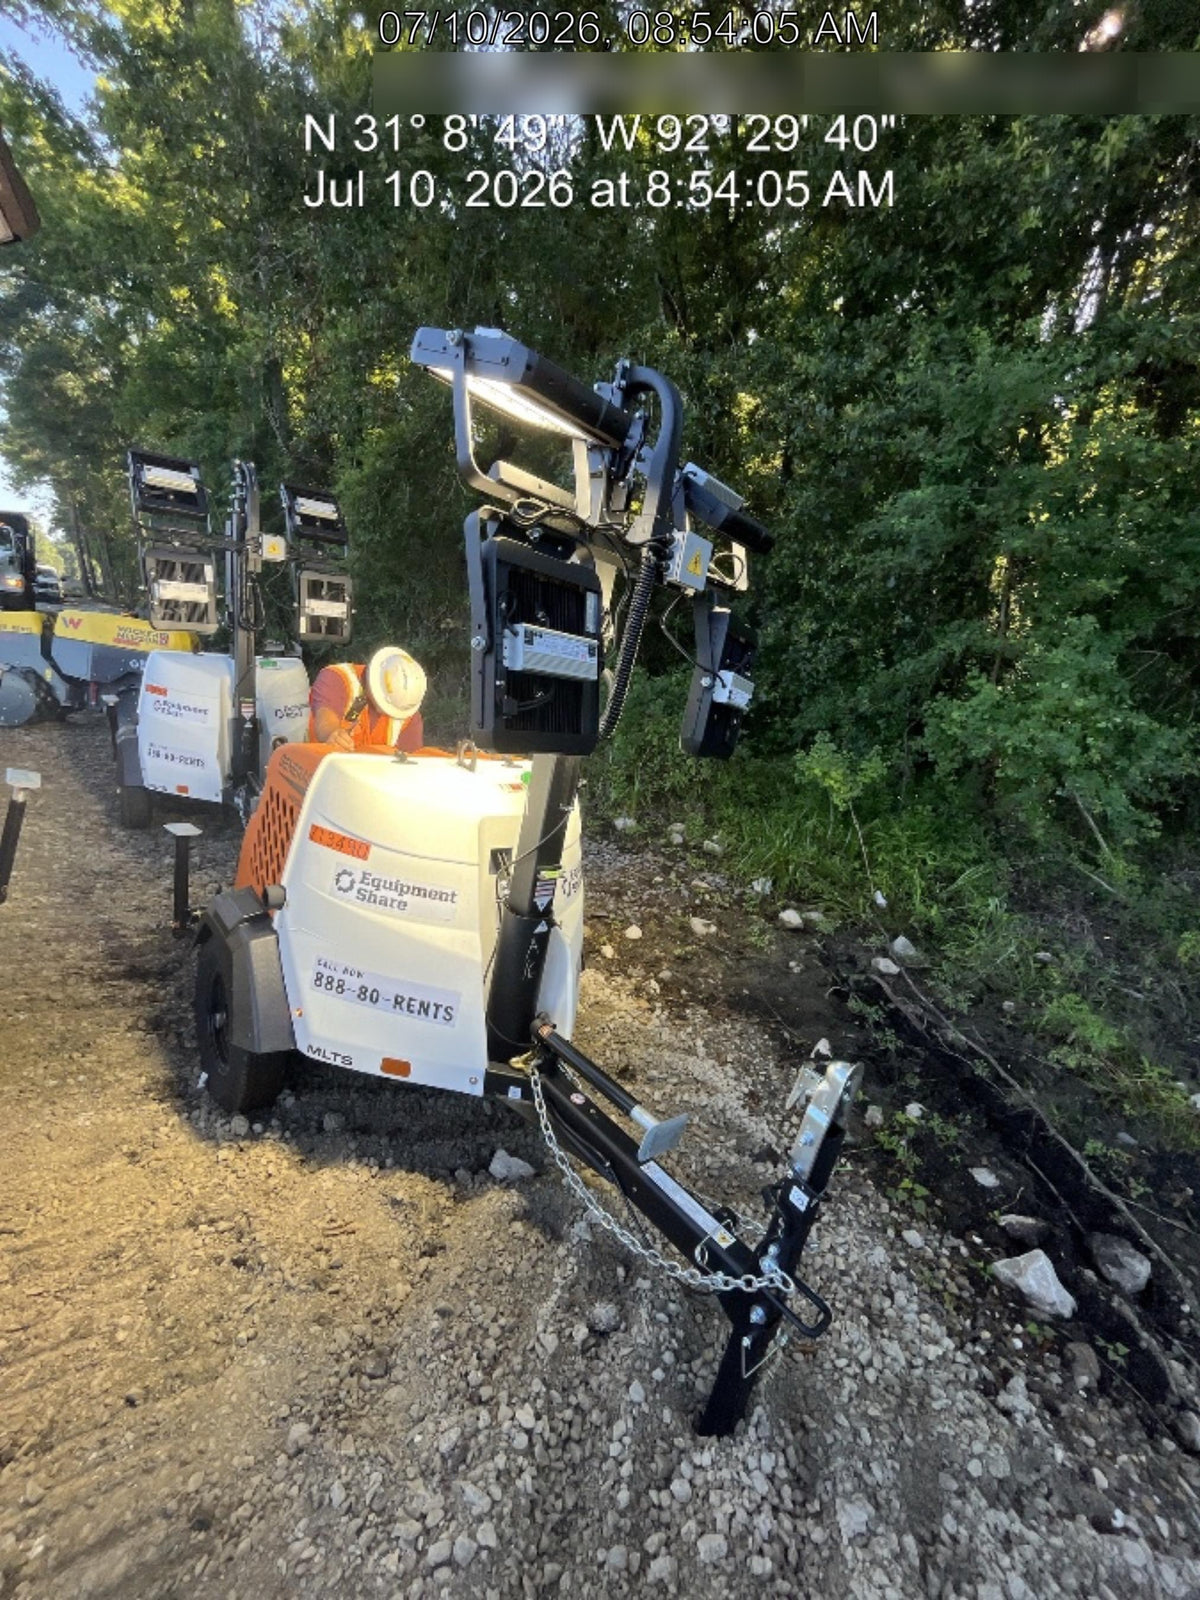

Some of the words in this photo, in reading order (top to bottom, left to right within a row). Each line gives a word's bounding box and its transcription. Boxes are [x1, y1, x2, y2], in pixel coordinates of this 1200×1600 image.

[355, 887, 408, 911] Share
[358, 871, 458, 904] Equipment
[306, 1044, 353, 1066] MLTS
